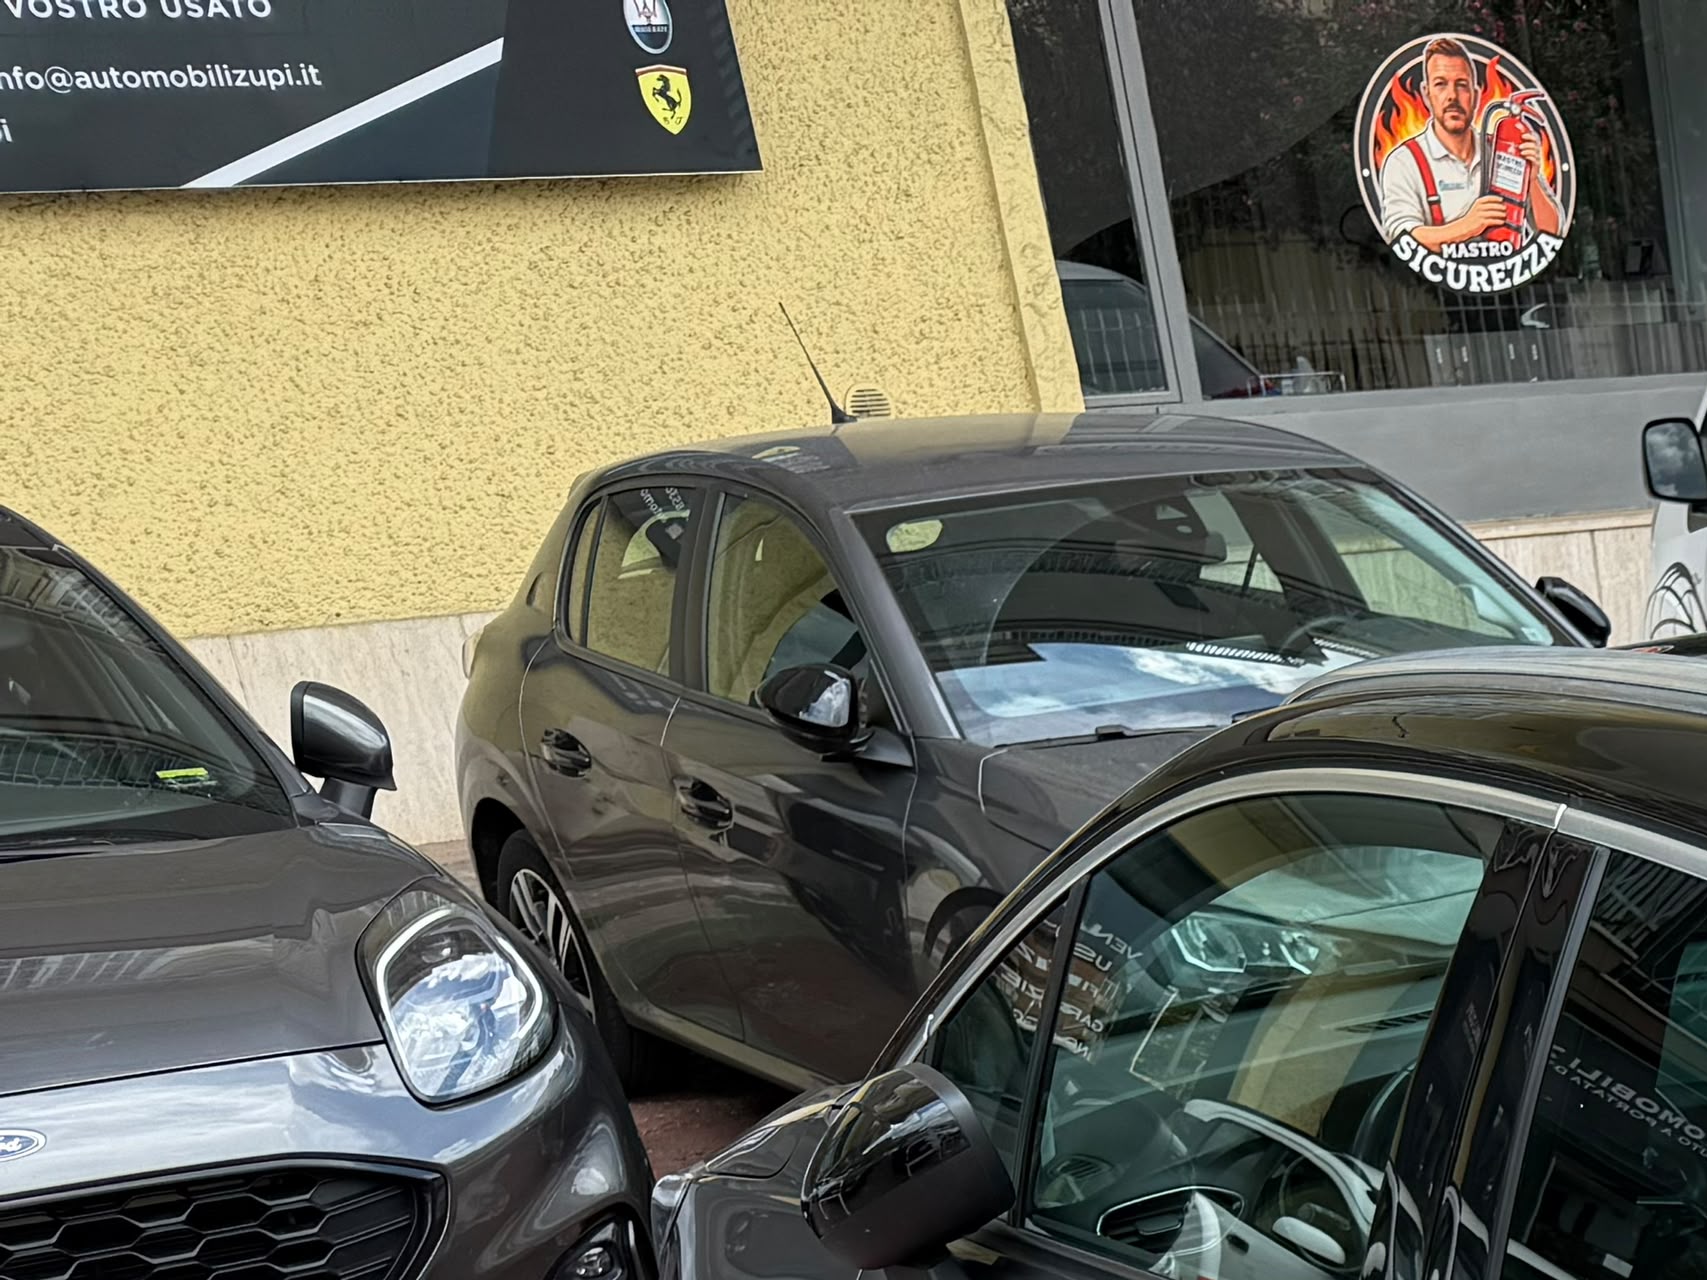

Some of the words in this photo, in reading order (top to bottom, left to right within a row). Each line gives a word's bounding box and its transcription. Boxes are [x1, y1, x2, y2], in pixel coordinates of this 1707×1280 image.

[8, 0, 147, 19] VOSTRO
[160, 0, 272, 19] USATO
[1442, 240, 1513, 259] MASTRO
[1392, 233, 1564, 292] SICUREZZA
